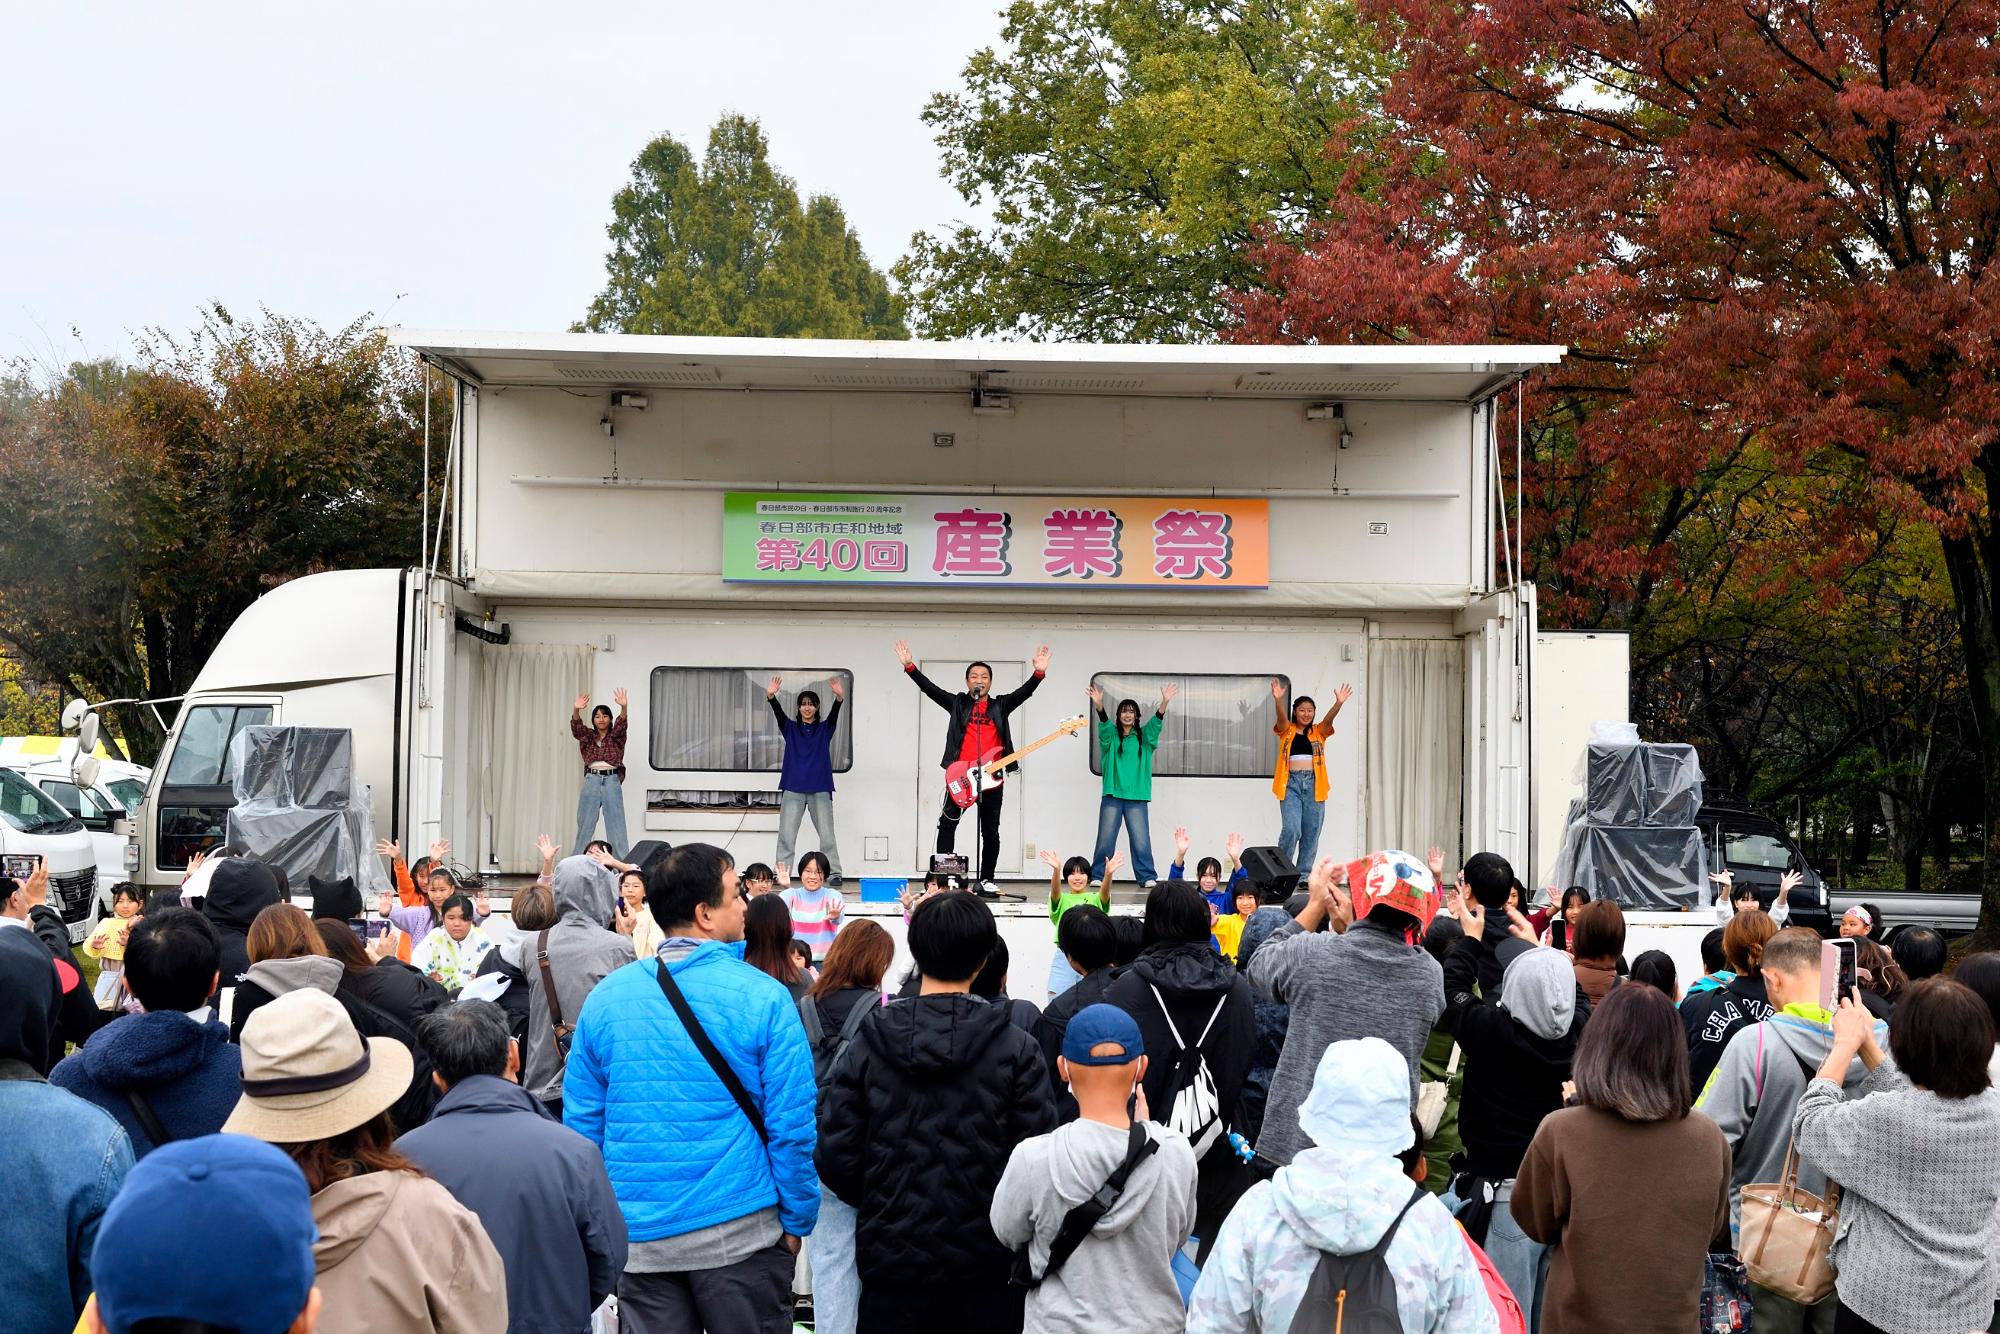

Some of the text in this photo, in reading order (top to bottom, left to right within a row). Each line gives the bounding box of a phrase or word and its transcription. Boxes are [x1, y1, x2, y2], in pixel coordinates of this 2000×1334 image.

[759, 521, 904, 535] 春日部市庄和地域
[932, 508, 1233, 579] 産業祭
[755, 538, 908, 572] 第40回
